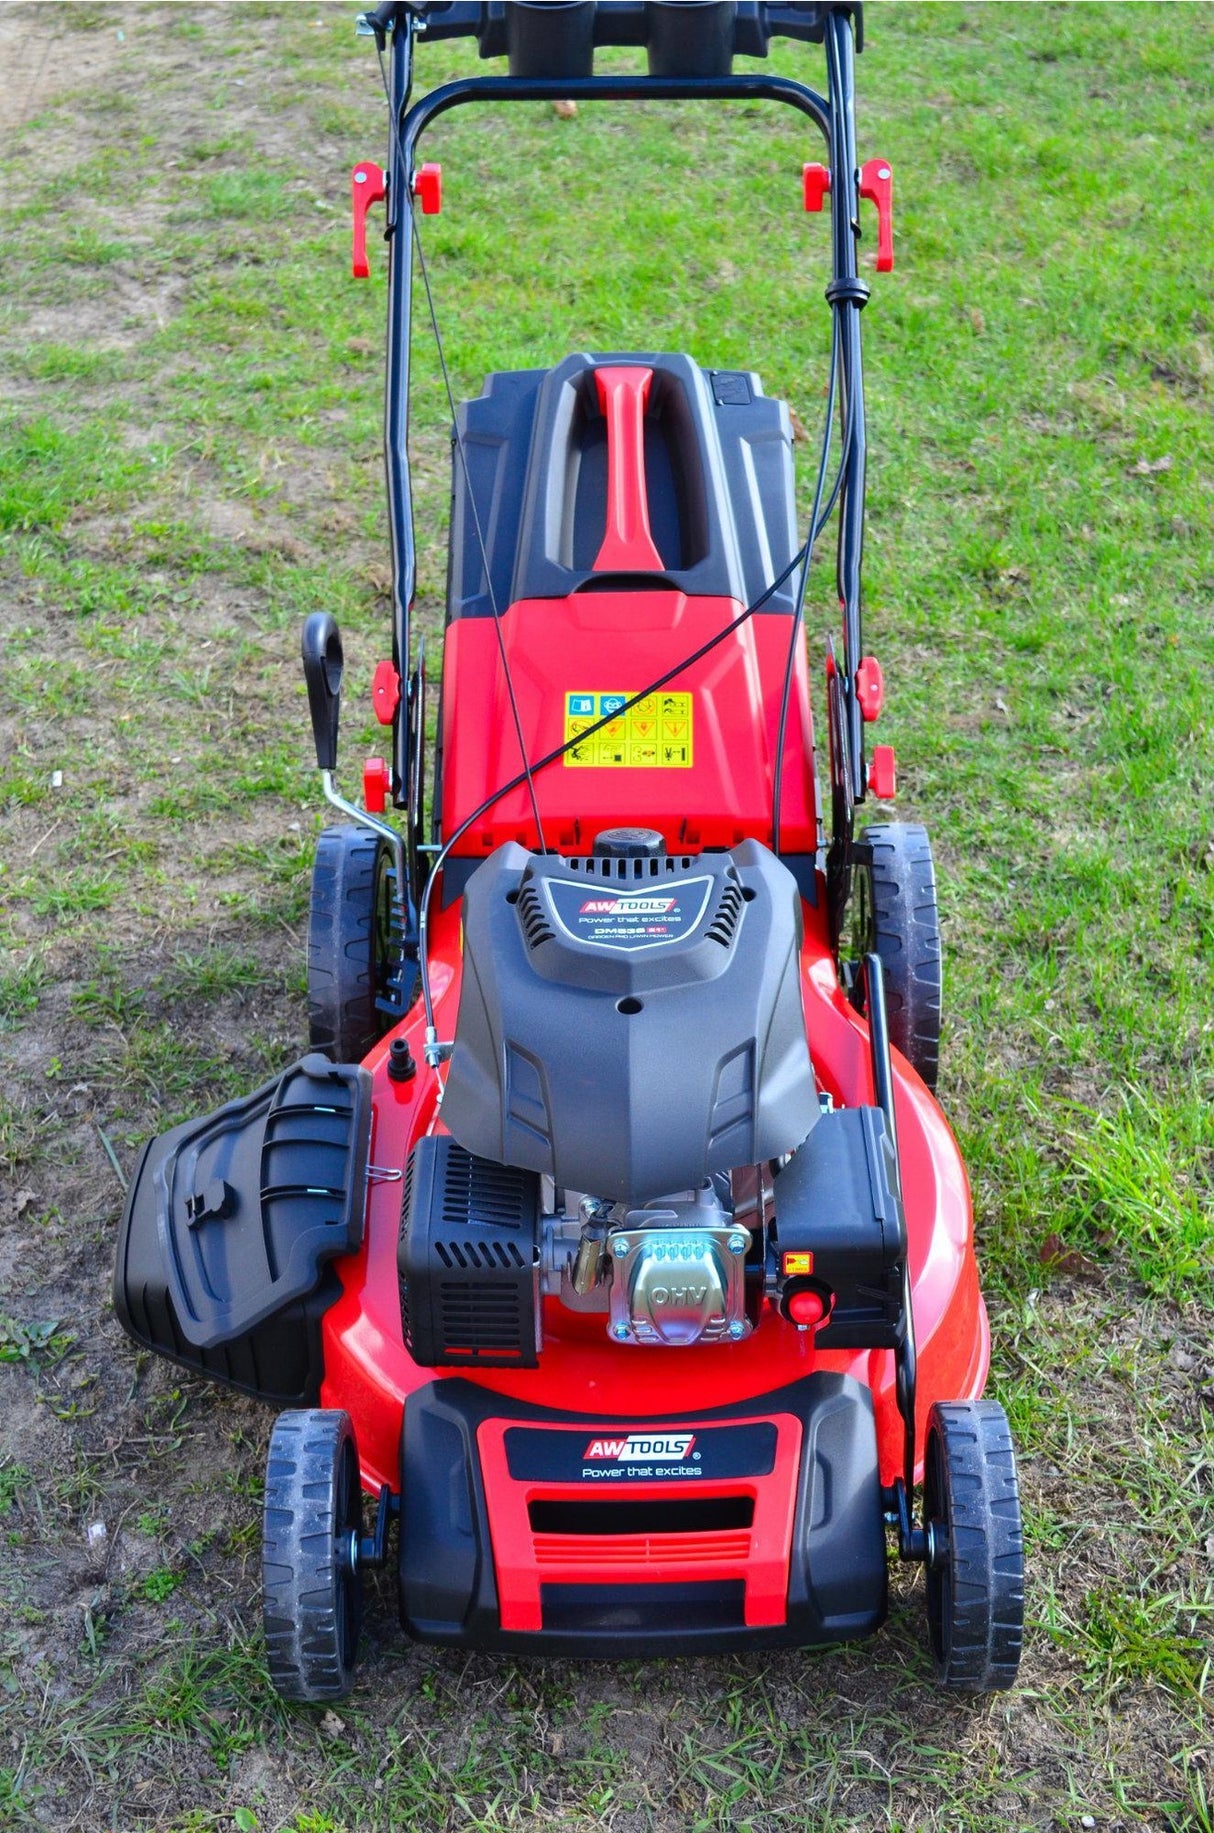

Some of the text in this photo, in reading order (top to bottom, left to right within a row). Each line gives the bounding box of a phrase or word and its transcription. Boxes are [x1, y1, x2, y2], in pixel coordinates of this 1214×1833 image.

[641, 915, 682, 923] excites
[651, 1286, 708, 1307] OHV
[582, 1465, 702, 1478] Power that excites
